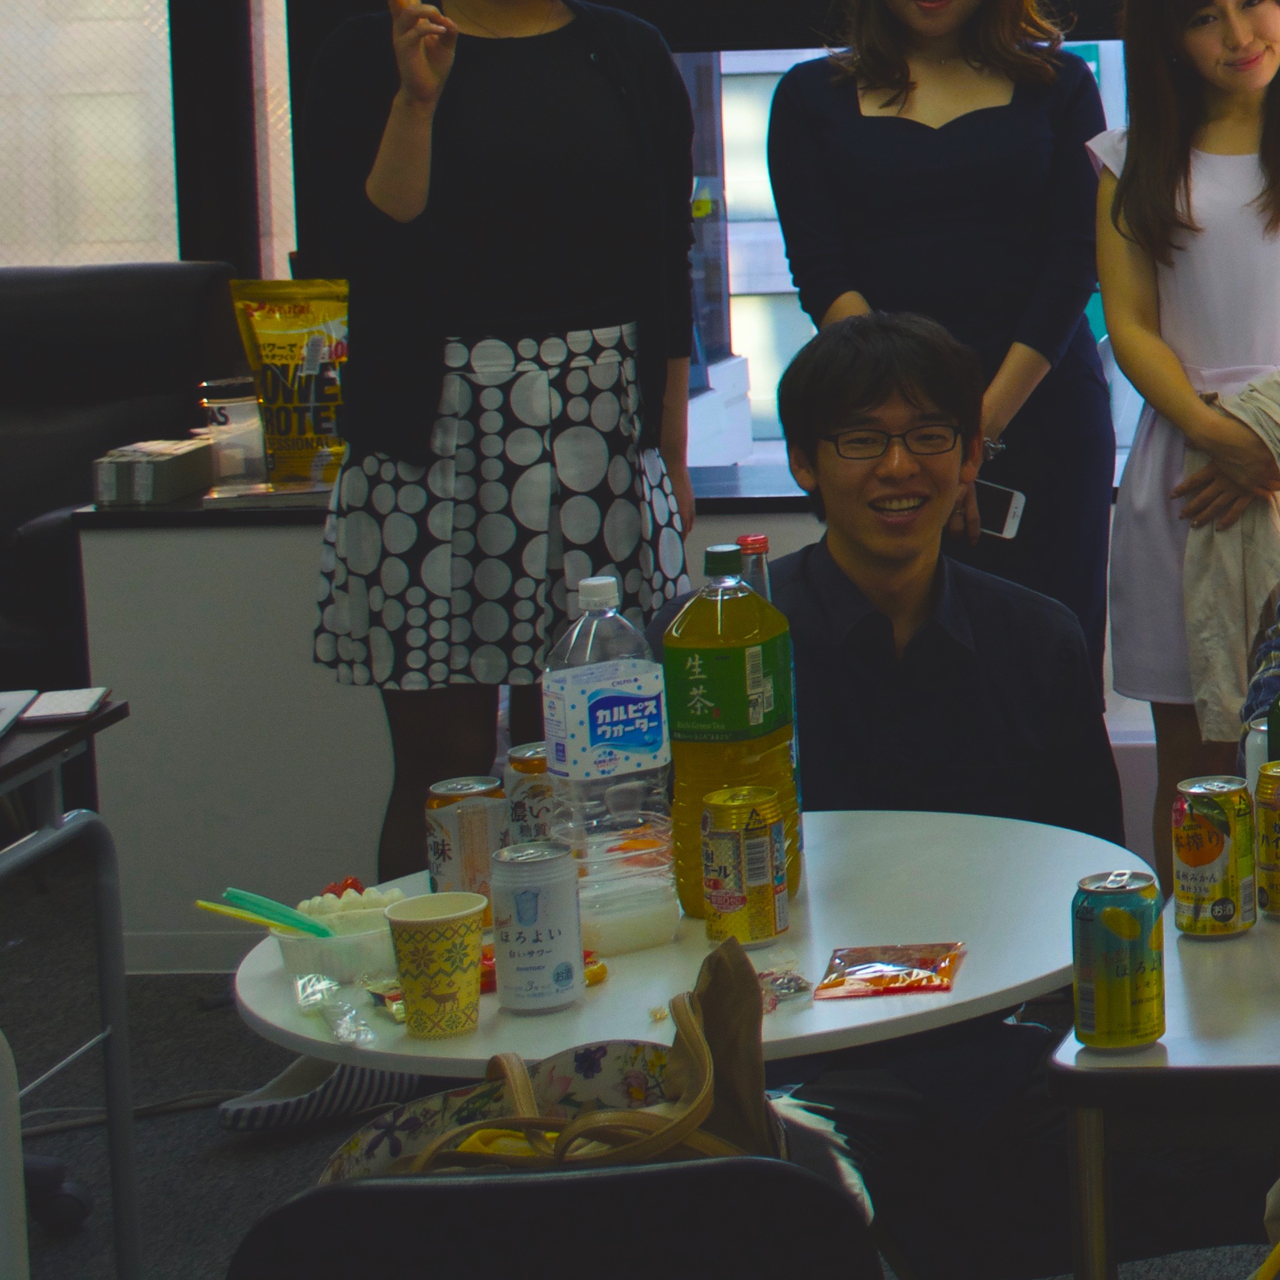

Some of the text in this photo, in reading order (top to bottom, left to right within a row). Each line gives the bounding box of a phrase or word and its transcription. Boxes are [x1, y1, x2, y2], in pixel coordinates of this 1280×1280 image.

[261, 363, 341, 404] OWE
[685, 653, 715, 716] 生茶
[595, 699, 658, 725] カルピス
[596, 717, 659, 740] ウォーター
[510, 799, 550, 823] 濃い
[1212, 904, 1234, 918] お酒
[501, 928, 562, 945] ほろよい
[555, 964, 574, 983] お酒
